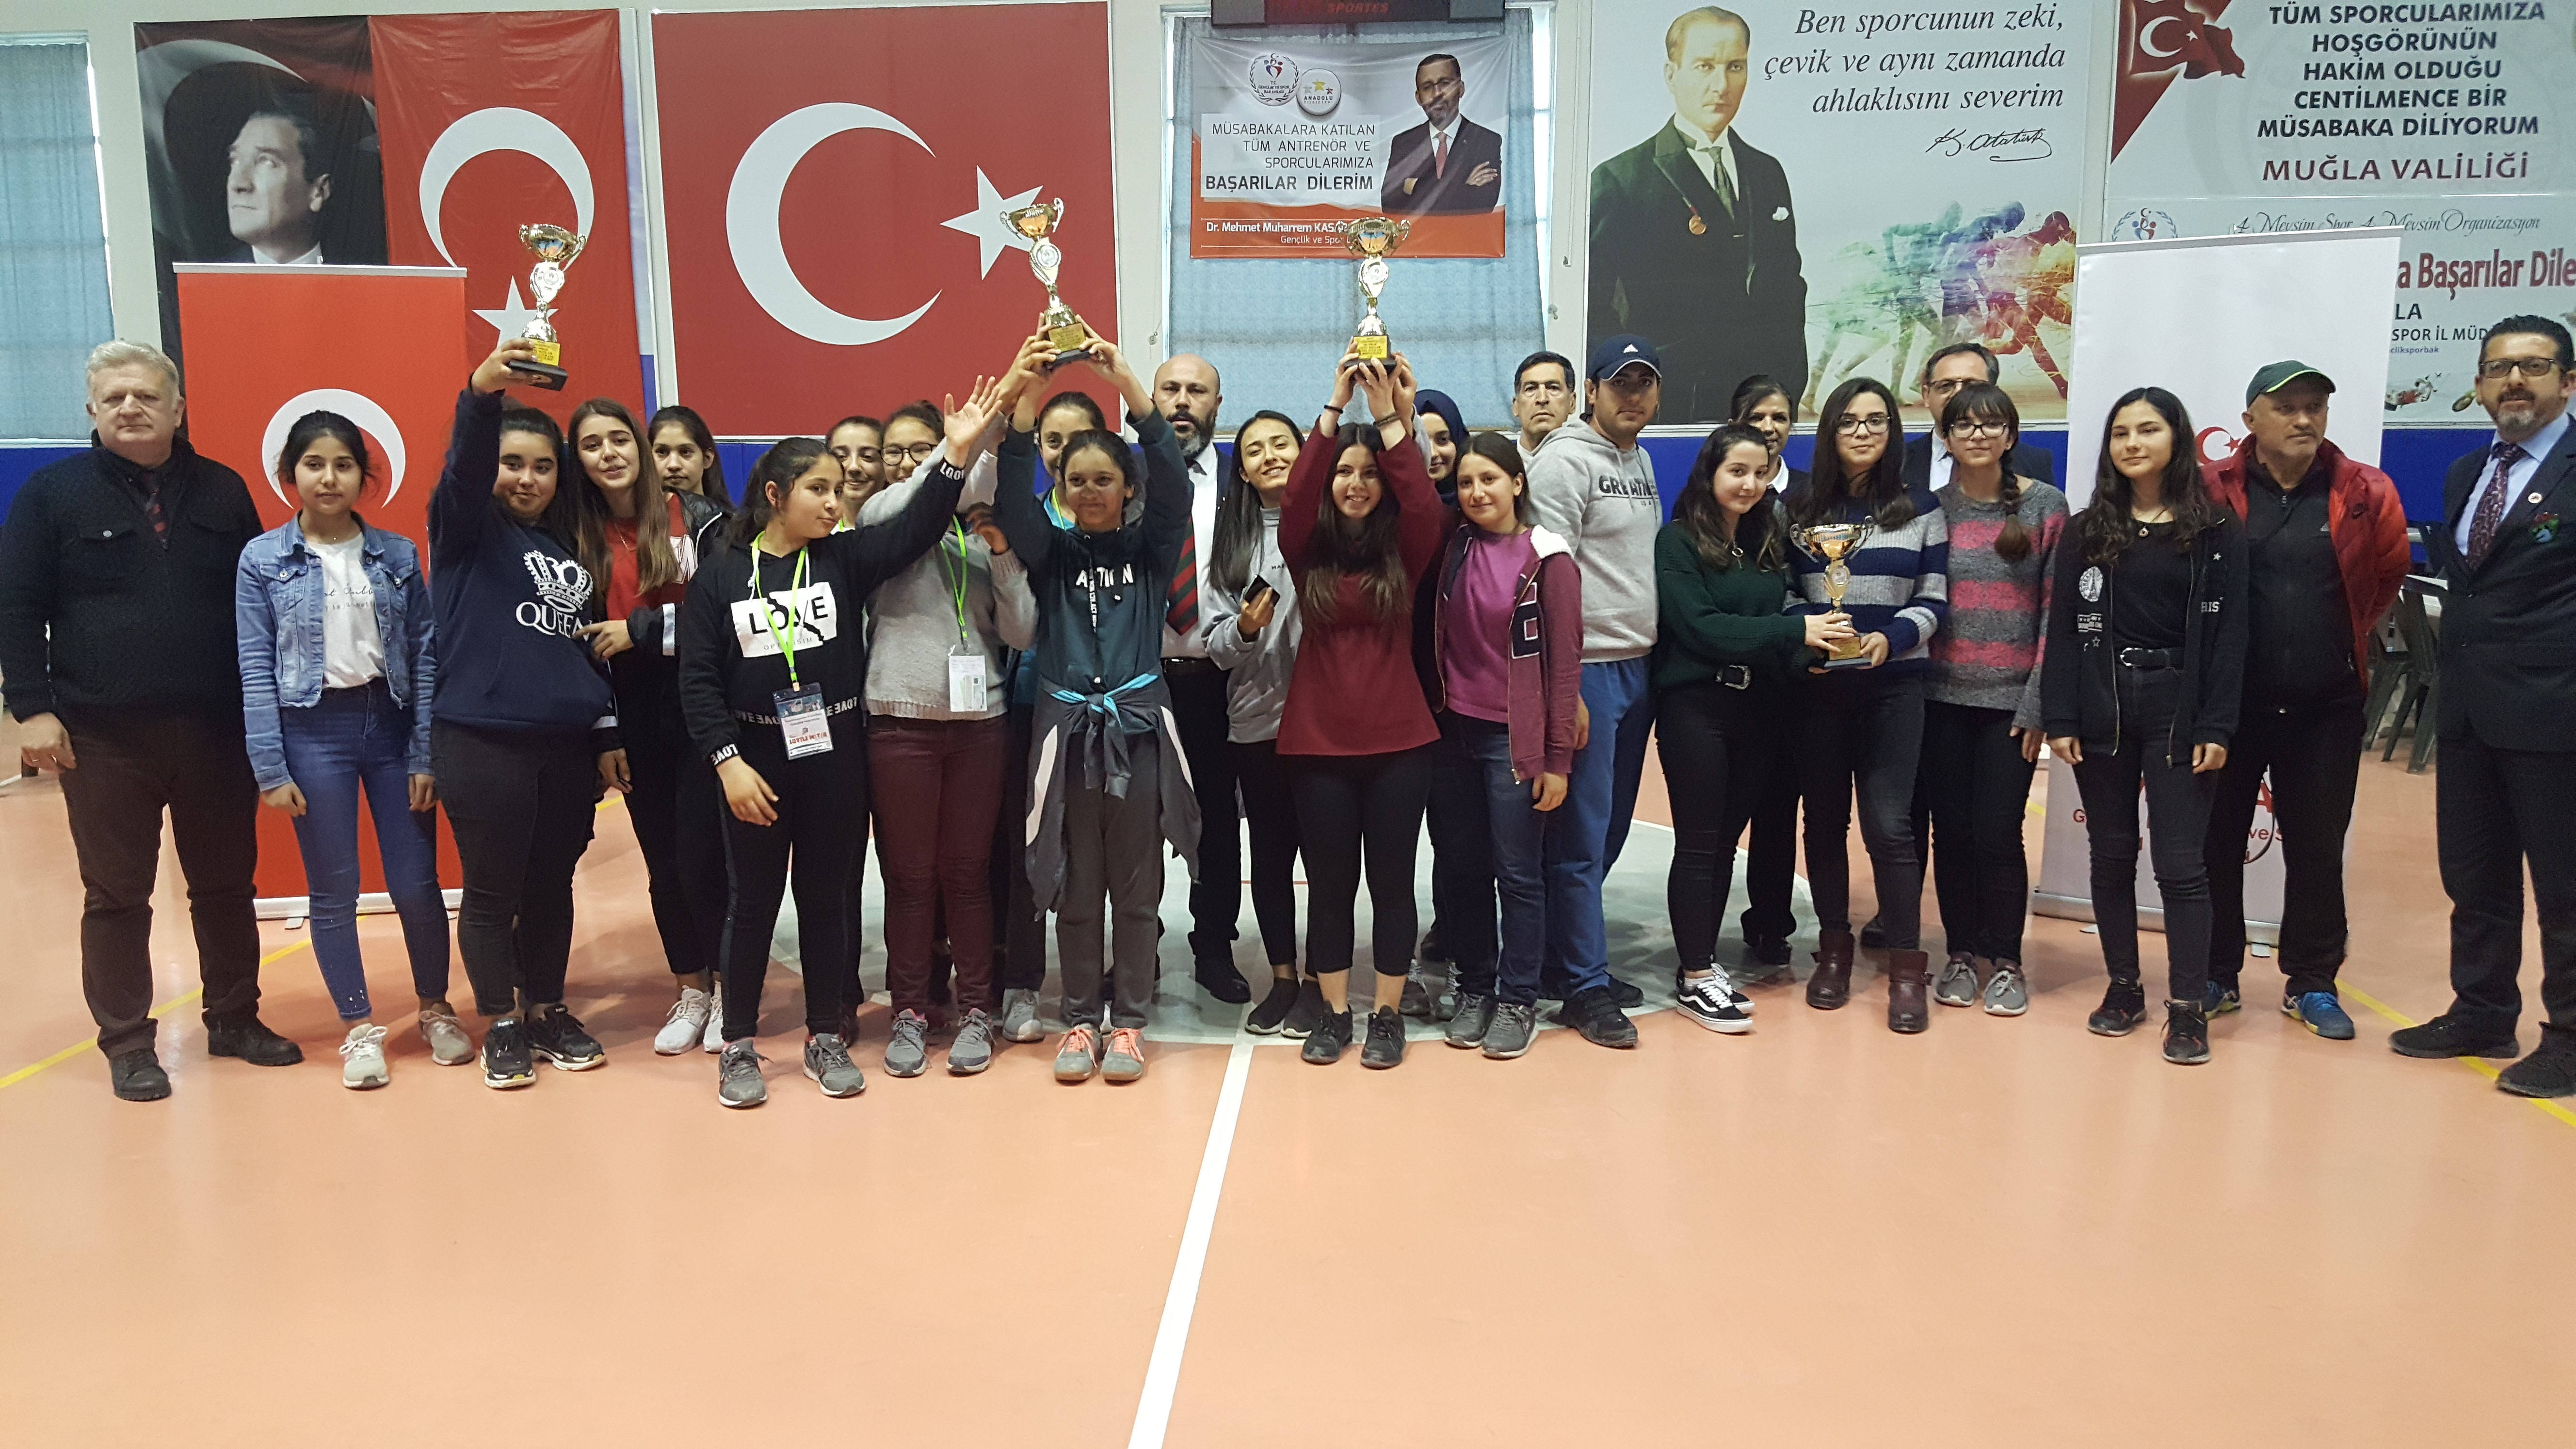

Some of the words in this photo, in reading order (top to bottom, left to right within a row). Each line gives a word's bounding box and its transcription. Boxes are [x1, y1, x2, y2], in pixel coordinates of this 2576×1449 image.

[1795, 9, 1846, 35] Ben
[1855, 8, 1994, 40] sporcunun
[2003, 3, 2063, 32] zeki,
[2269, 1, 2321, 26] TÜM
[2329, 1, 2545, 24] SPORCULARIMIZA
[2312, 29, 2497, 57] HOŞGÖRÜNÜN
[1764, 48, 1831, 80] çevik
[1843, 55, 1868, 73] ve
[1879, 51, 1935, 78] aynı
[1945, 43, 2065, 72] zamanda
[2303, 57, 2384, 80] HAKİM
[2394, 54, 2501, 80] OLDUĞU
[1812, 87, 1948, 113] ahlaklısını
[1960, 82, 2063, 110] severim
[2294, 85, 2459, 109] CENTİLMENCE
[2468, 84, 2506, 107] BİR
[1212, 121, 1317, 135] MÜSABAKALARA
[1321, 124, 1375, 135] KATILAN
[2257, 114, 2394, 138] MÜSABAKA
[2402, 111, 2539, 136] DİLİYORUM
[1243, 138, 1270, 151] TÜM
[1278, 139, 1347, 151] ANTRENÖR
[1354, 141, 1370, 151] VE
[1265, 157, 1374, 168] SPORCULARIMIZA
[2262, 155, 2381, 182] MUĞLA
[2391, 151, 2528, 180] VALİLİĞİ
[1206, 176, 1297, 193] BAŞARILAR
[1307, 173, 1373, 190] DİLERİM
[1207, 222, 1219, 232] Dr.
[1222, 222, 1260, 232] Mehmet
[1262, 222, 1312, 232] Muharrem
[2441, 209, 2541, 237] Organizasyon
[1281, 235, 1310, 244] Gençlik
[2418, 248, 2525, 301] Başarılar
[2391, 328, 2431, 341] SPOR
[2436, 325, 2448, 340] İL
